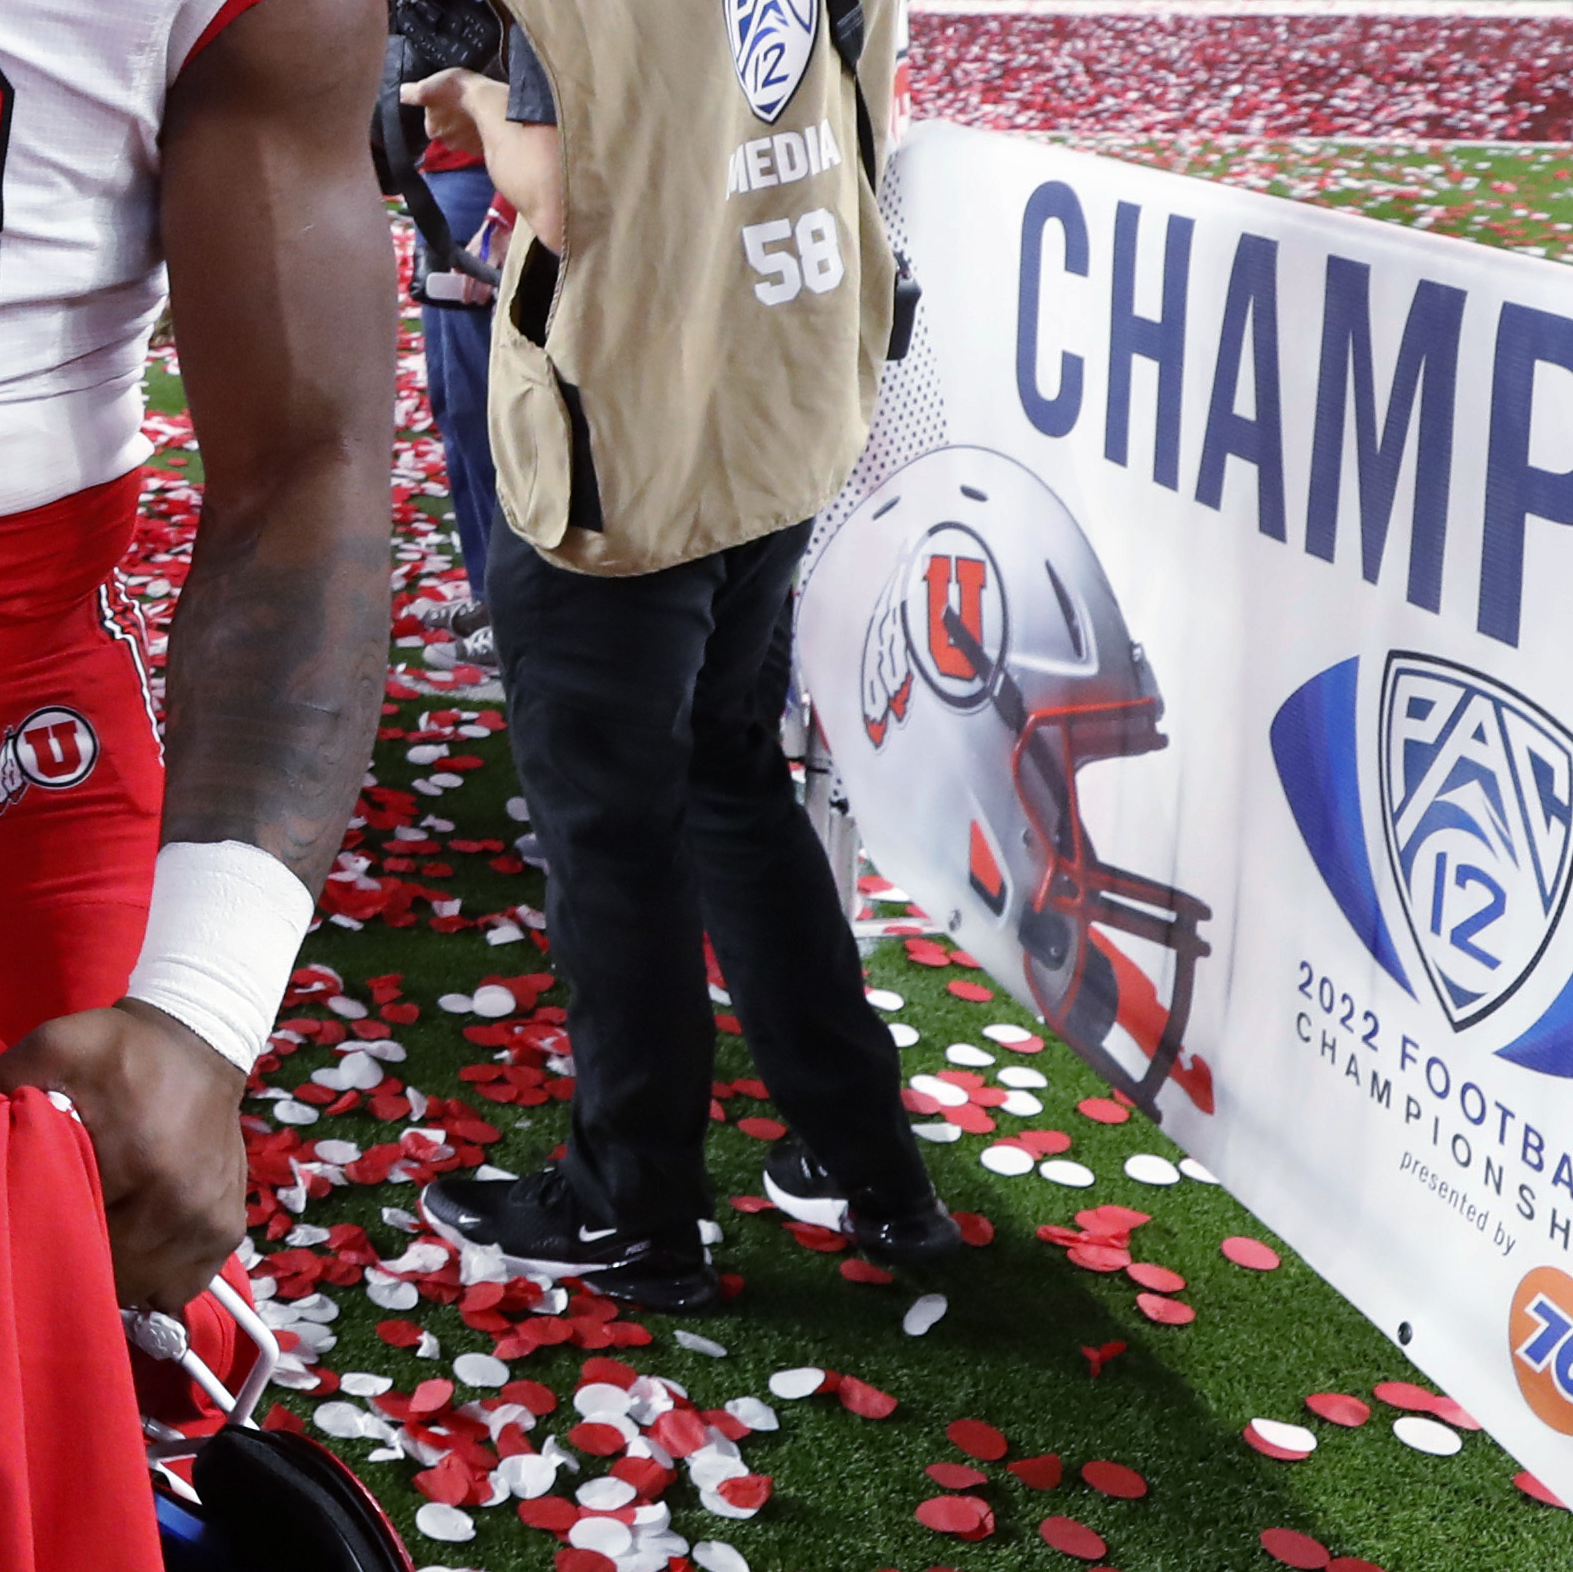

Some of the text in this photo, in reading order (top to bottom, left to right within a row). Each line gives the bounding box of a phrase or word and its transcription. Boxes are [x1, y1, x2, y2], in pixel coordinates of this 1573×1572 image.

[753, 42, 791, 94] 12
[742, 206, 846, 308] 58
[23, 723, 88, 778] U
[1392, 686, 1571, 918] PAC
[1429, 850, 1508, 973] 12
[1296, 959, 1381, 1053] 2022
[1399, 1151, 1517, 1257] presented by
